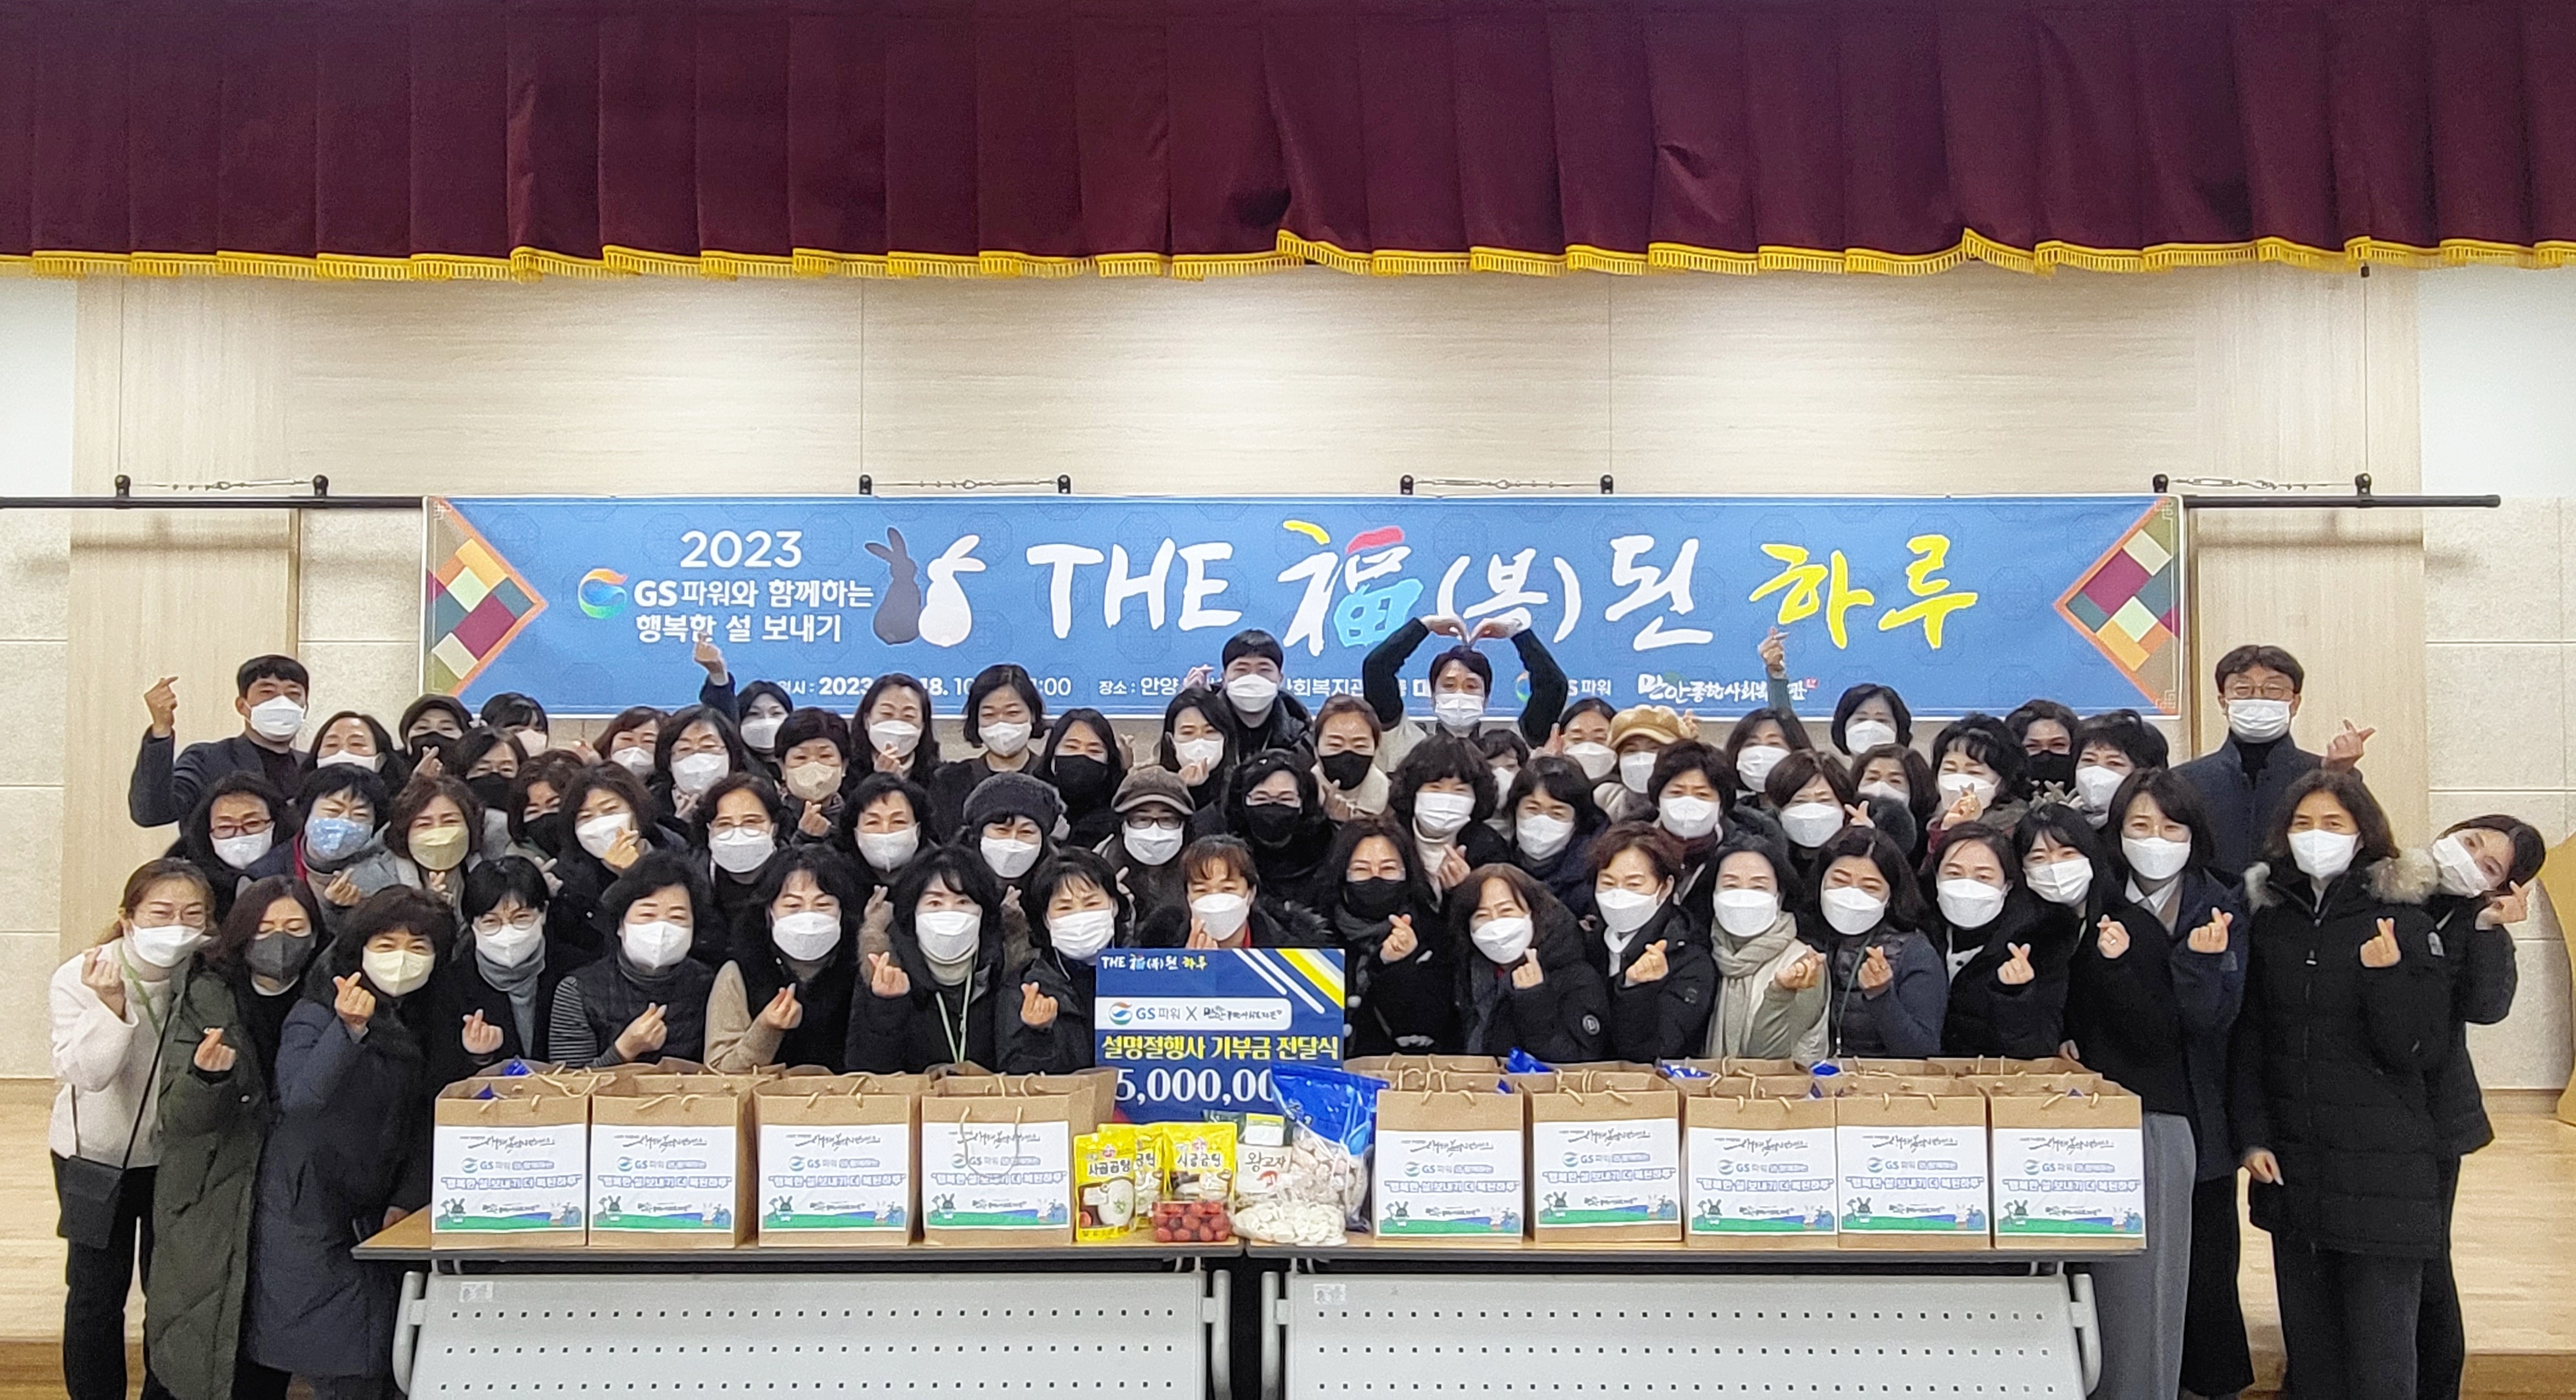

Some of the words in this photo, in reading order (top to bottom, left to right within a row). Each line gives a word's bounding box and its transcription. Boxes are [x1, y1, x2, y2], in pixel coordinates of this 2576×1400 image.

[680, 530, 803, 568] 2023
[768, 579, 874, 608] 함께하는
[1027, 538, 1242, 639] THE
[1749, 534, 1978, 648] 하루
[635, 614, 717, 643] 행복한
[726, 614, 751, 643] 설
[762, 614, 841, 643] 보내기
[1638, 674, 1808, 704] 만안종합사회복관
[1101, 956, 1127, 969] THE
[1182, 955, 1208, 971] 하루
[1136, 1007, 1156, 1020] GS
[1101, 1034, 1206, 1061] 설명절행사
[1210, 1034, 1271, 1061] 기부금
[1275, 1034, 1339, 1061] 전달식
[1115, 1067, 1273, 1106] 5,000,00
[635, 1160, 648, 1169] GS
[807, 1159, 820, 1168] GS
[969, 1157, 982, 1166] GS
[1580, 1155, 1594, 1163] GS
[480, 1161, 494, 1169] GS
[1422, 1165, 1435, 1173] GS
[1736, 1164, 1750, 1172] GS
[1886, 1161, 1899, 1169] GS
[2042, 1163, 2056, 1172] GS
